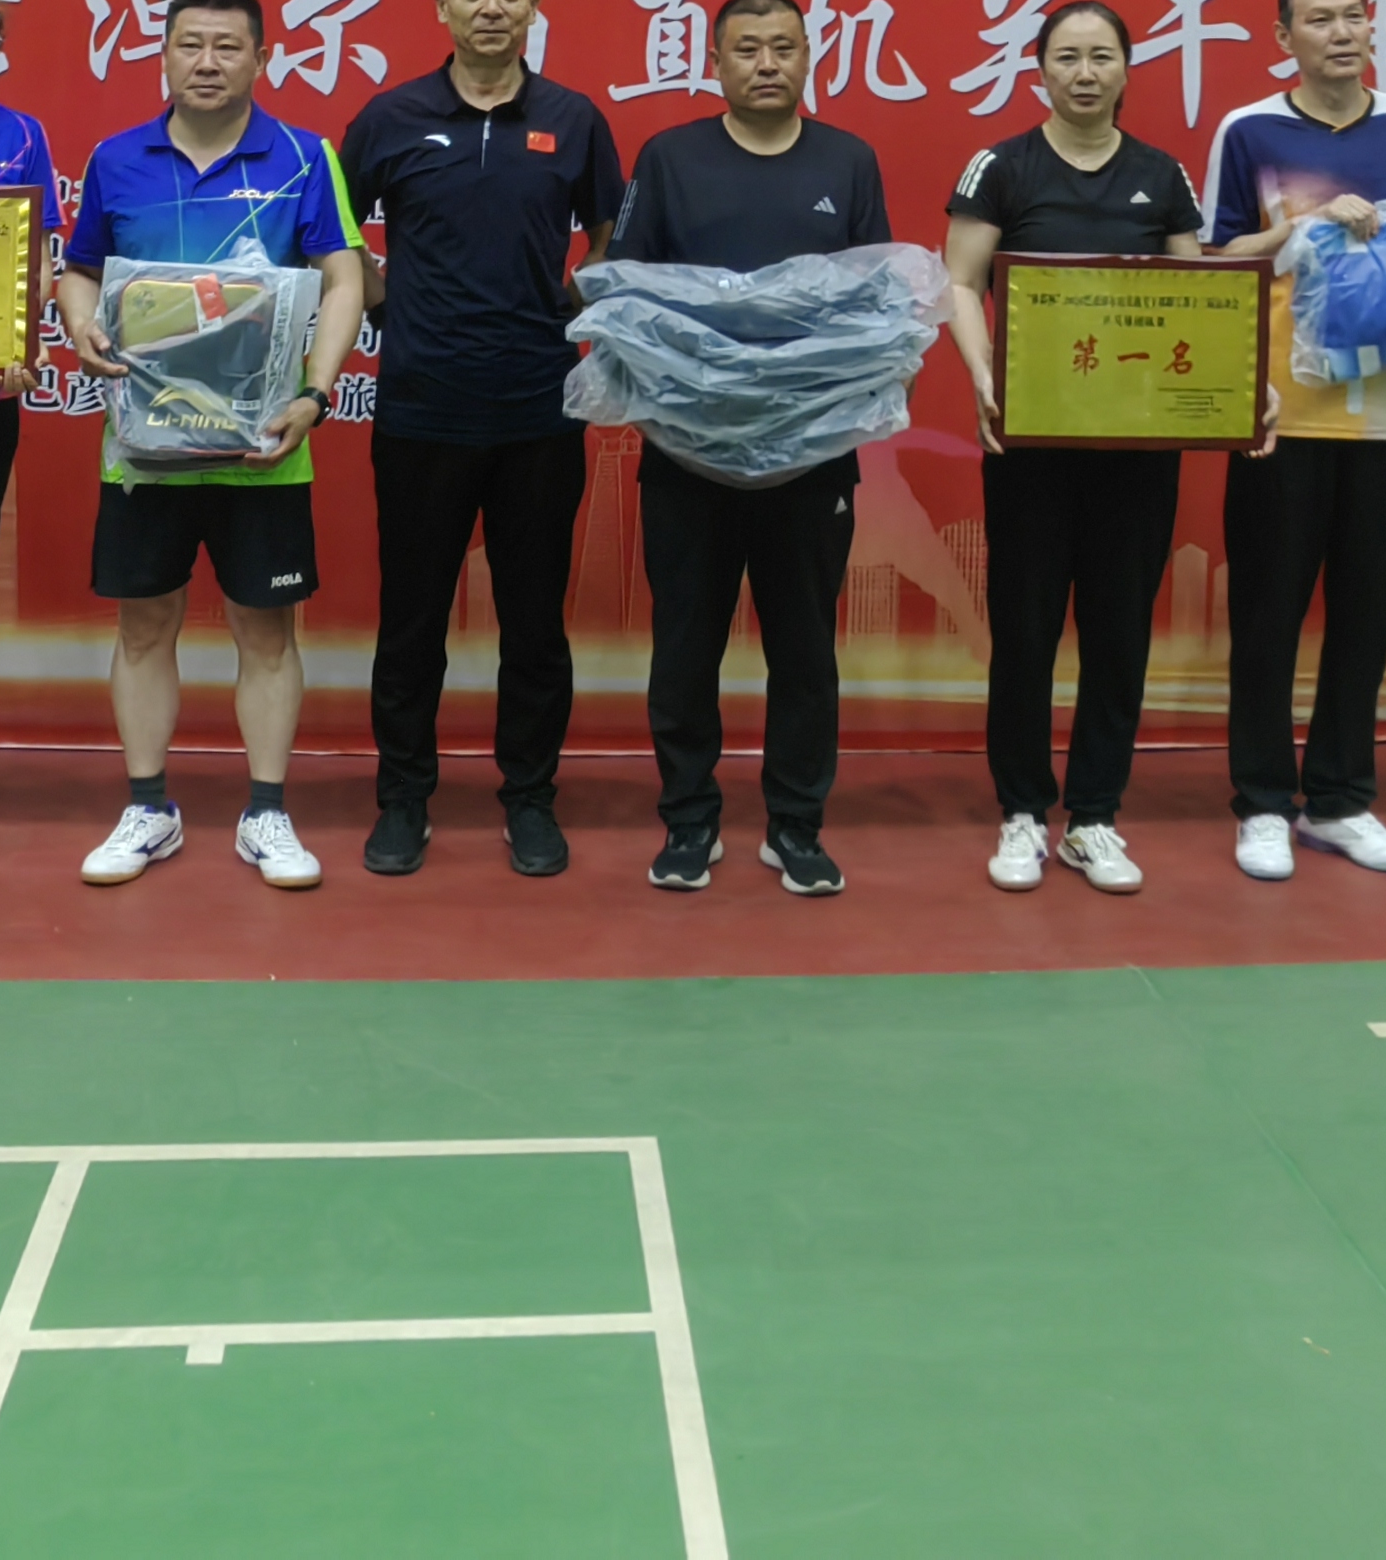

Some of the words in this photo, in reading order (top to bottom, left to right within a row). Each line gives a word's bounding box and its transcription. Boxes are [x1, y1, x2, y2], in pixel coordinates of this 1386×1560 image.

[1072, 333, 1194, 377] 第一名
[270, 572, 303, 588] JOOLA
